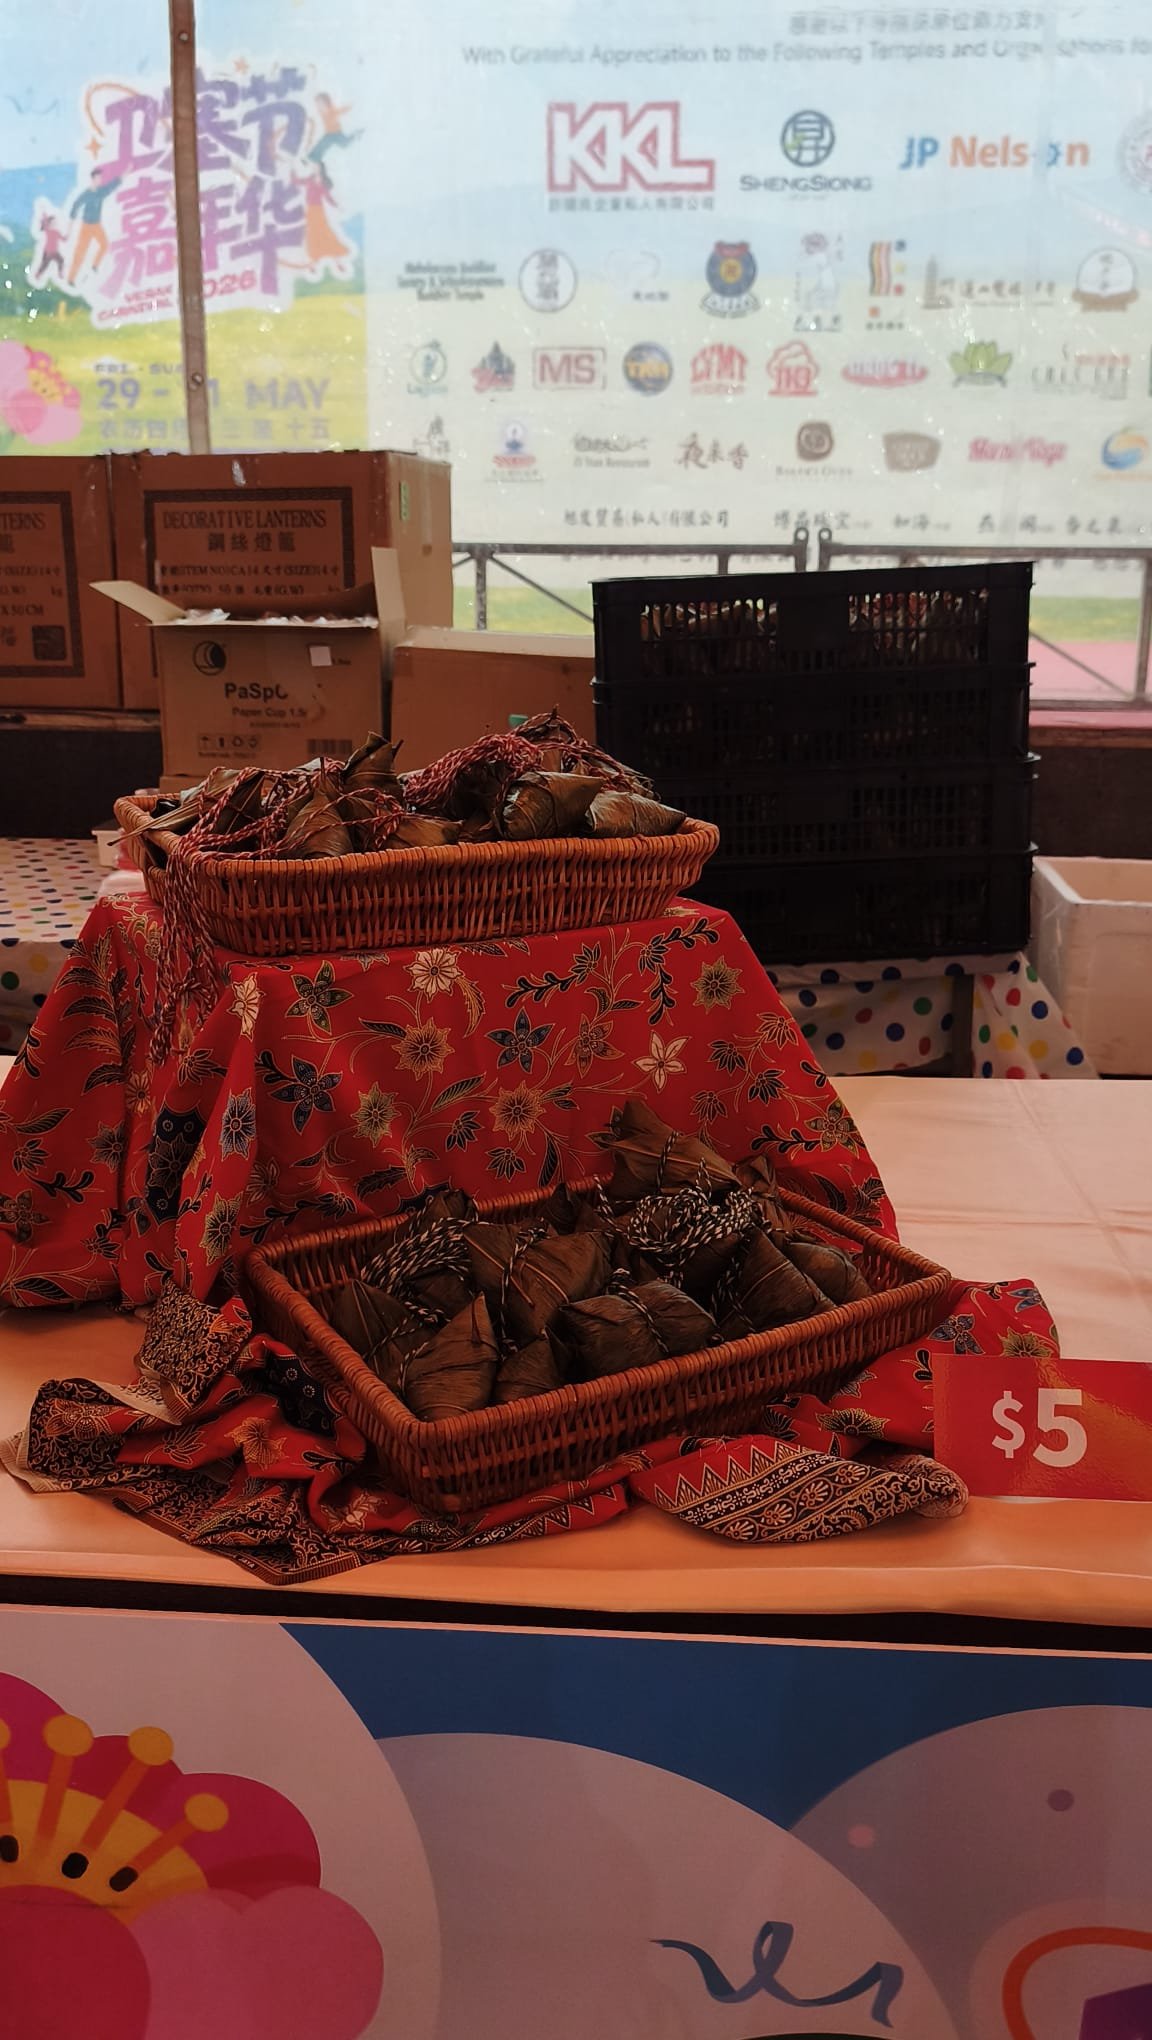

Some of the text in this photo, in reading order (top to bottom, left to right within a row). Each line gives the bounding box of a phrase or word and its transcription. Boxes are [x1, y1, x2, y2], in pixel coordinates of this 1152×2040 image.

[463, 48, 505, 63] With
[511, 47, 584, 64] Grateful
[590, 47, 706, 67] Appreciation
[712, 46, 731, 62] to
[737, 46, 768, 62] the
[773, 43, 862, 65] Following
[868, 40, 945, 63] Temples
[951, 41, 987, 59] and
[547, 101, 715, 192] KKL
[900, 137, 939, 170] JP
[100, 171, 306, 298] 嘉年华
[202, 270, 257, 299] 026
[539, 353, 597, 385] MS
[97, 378, 141, 410] 29
[245, 378, 330, 410] MAY
[163, 509, 327, 529] DECORATIVE LANTERNS
[232, 707, 262, 718] Paper
[265, 707, 287, 719] Cup
[991, 1387, 1088, 1468] $5
